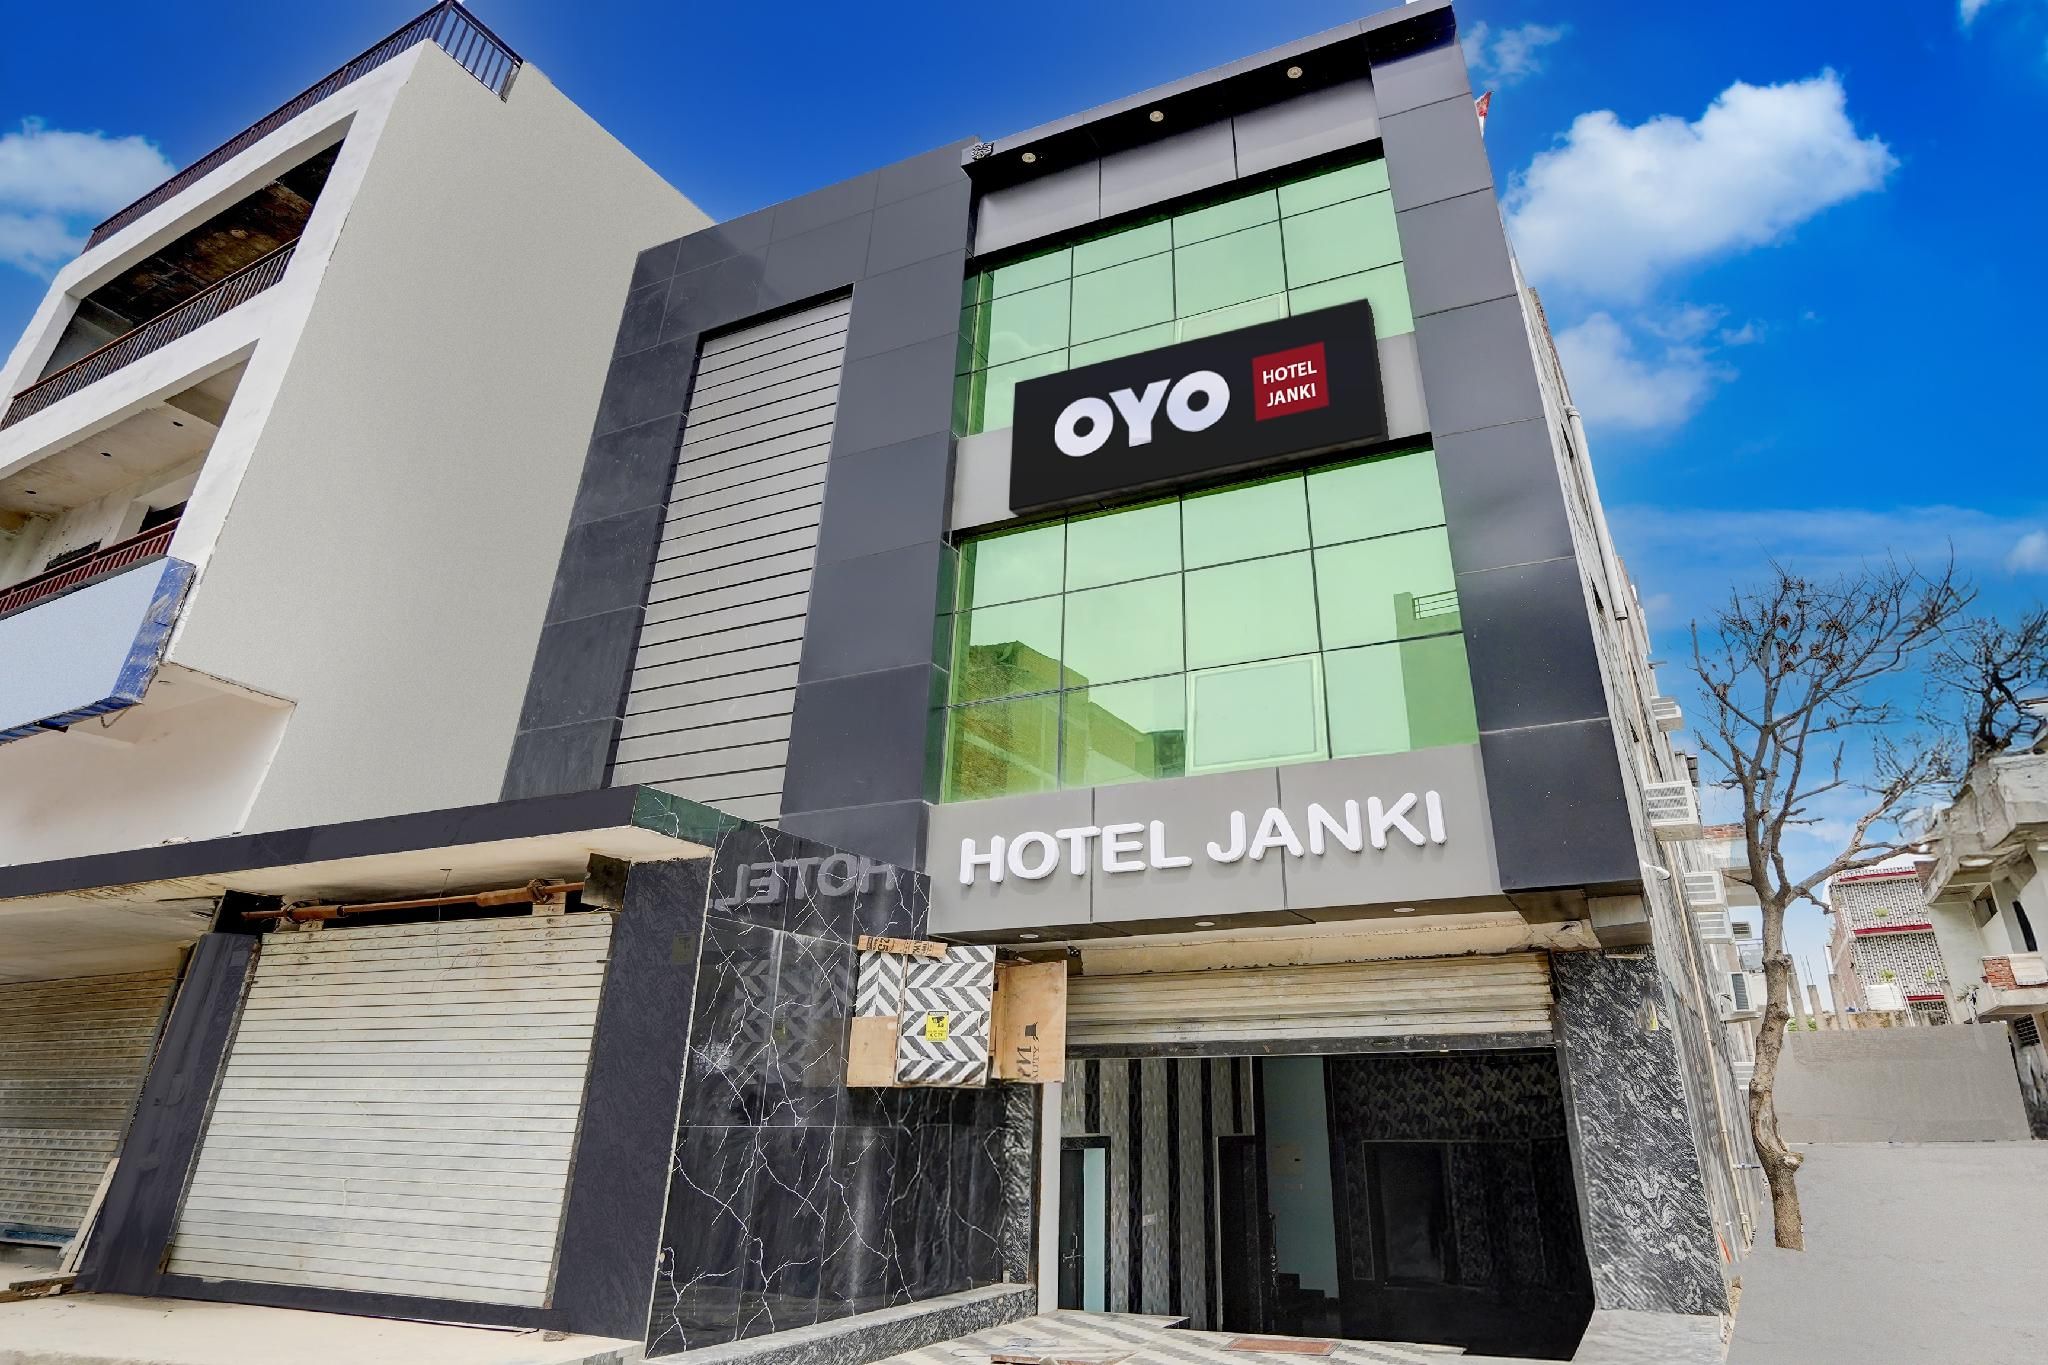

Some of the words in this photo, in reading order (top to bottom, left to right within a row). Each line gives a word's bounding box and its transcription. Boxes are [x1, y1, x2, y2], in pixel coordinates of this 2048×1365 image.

[1262, 360, 1318, 386] HOTEL
[1266, 382, 1316, 408] JANKI
[1054, 370, 1231, 458] OYO
[959, 819, 1194, 886] HOTEL
[1207, 789, 1448, 863] JANKI
